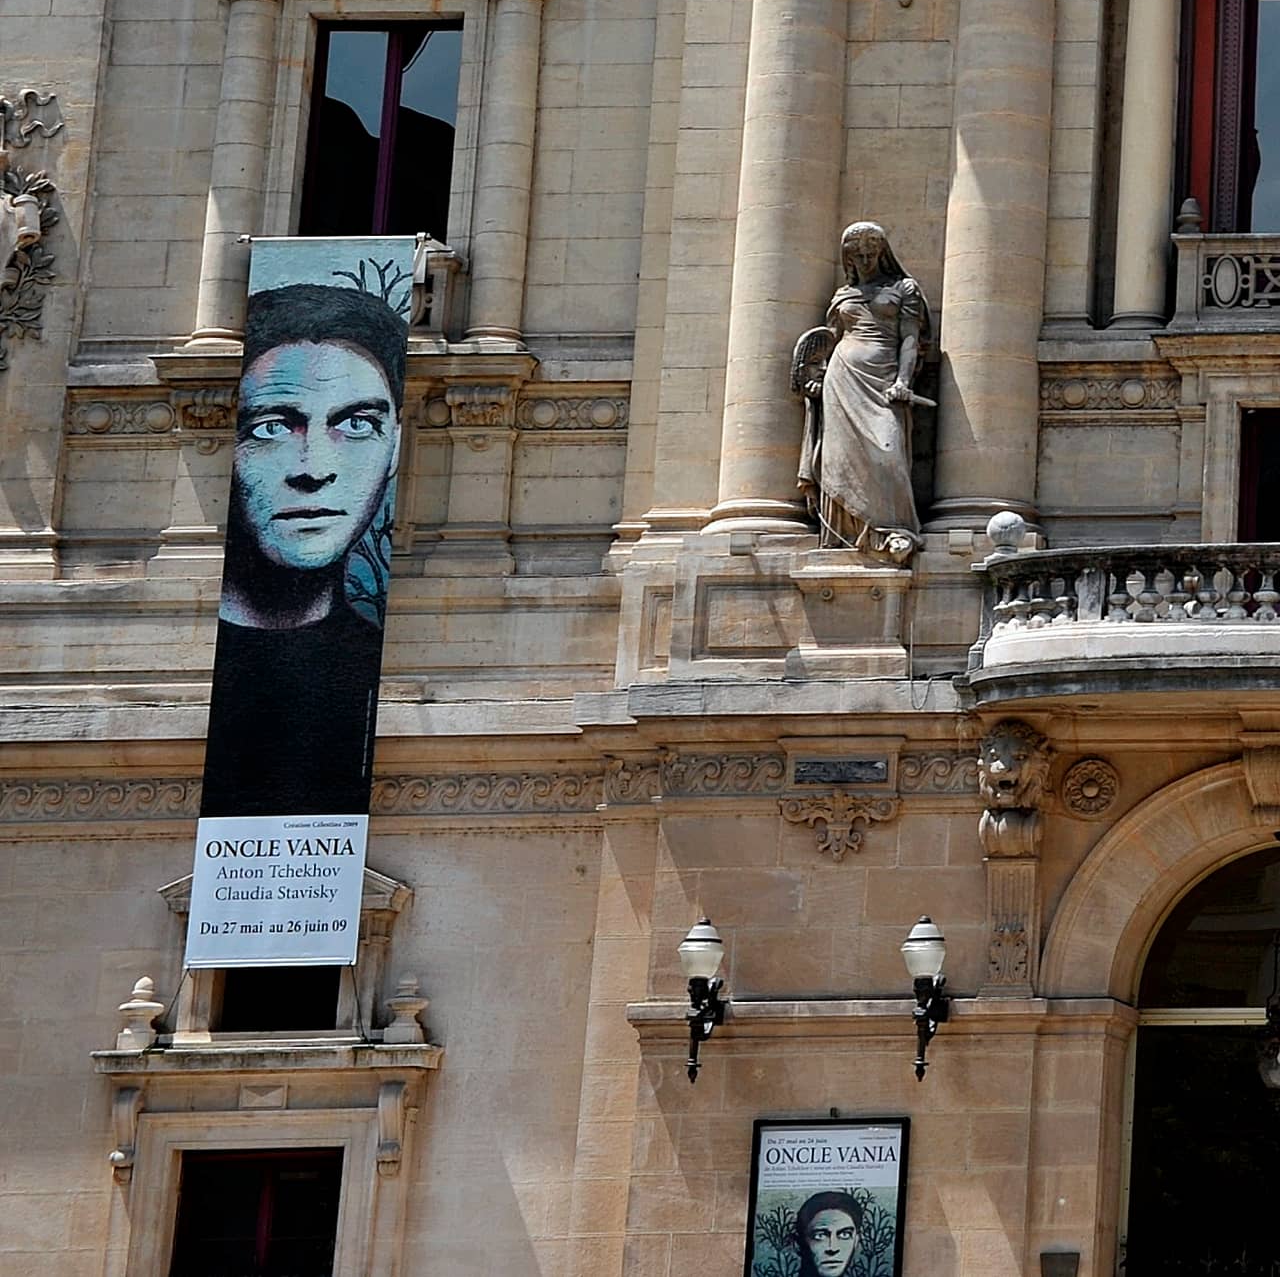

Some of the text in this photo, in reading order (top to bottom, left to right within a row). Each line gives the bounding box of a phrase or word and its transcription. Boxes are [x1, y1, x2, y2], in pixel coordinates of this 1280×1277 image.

[206, 837, 355, 858] ONCLE VANIA
[216, 863, 341, 880] Anton Tchekhov
[215, 884, 338, 903] Claudia Stavisky
[200, 919, 347, 936] Du 27 mai au 26 juin 09
[766, 1145, 897, 1165] ONCLE VANIA
